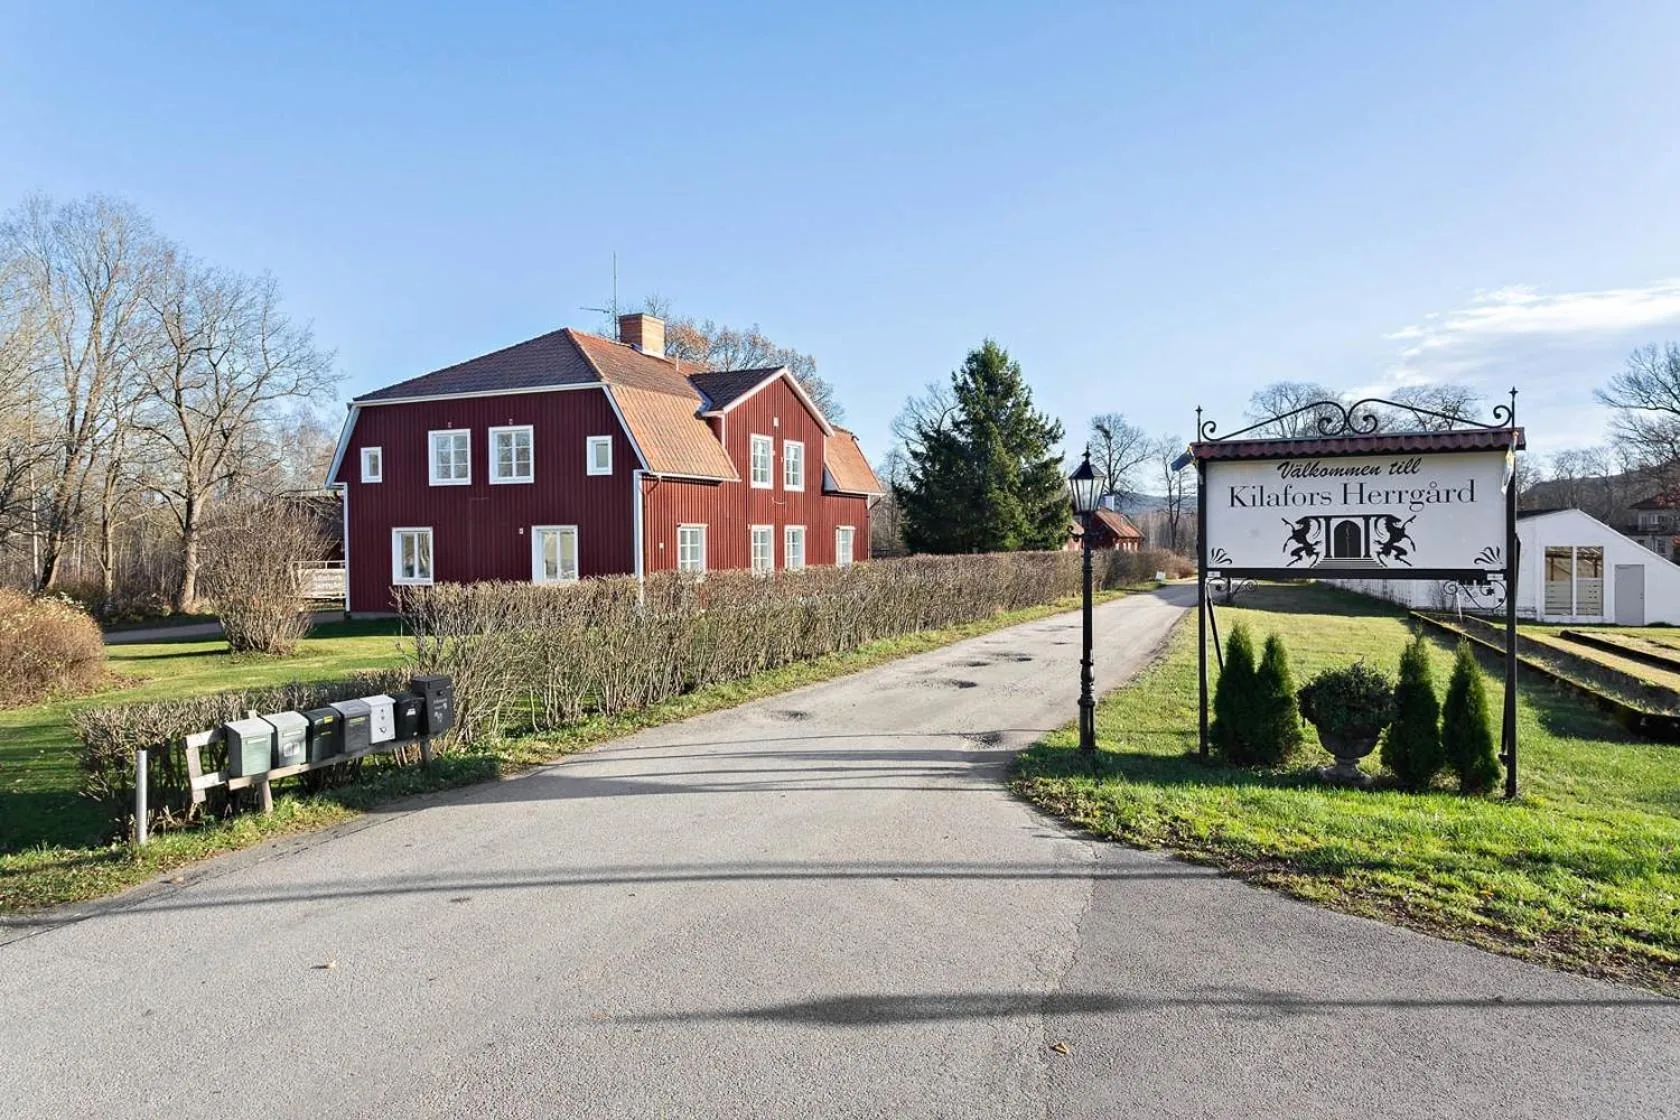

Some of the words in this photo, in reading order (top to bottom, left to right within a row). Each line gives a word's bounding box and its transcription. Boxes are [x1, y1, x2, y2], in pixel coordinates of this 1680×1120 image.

[1277, 460, 1382, 479] Välkommen
[1388, 457, 1422, 475] till
[1228, 483, 1332, 508] Kilafors
[1341, 479, 1477, 512] Herrgård
